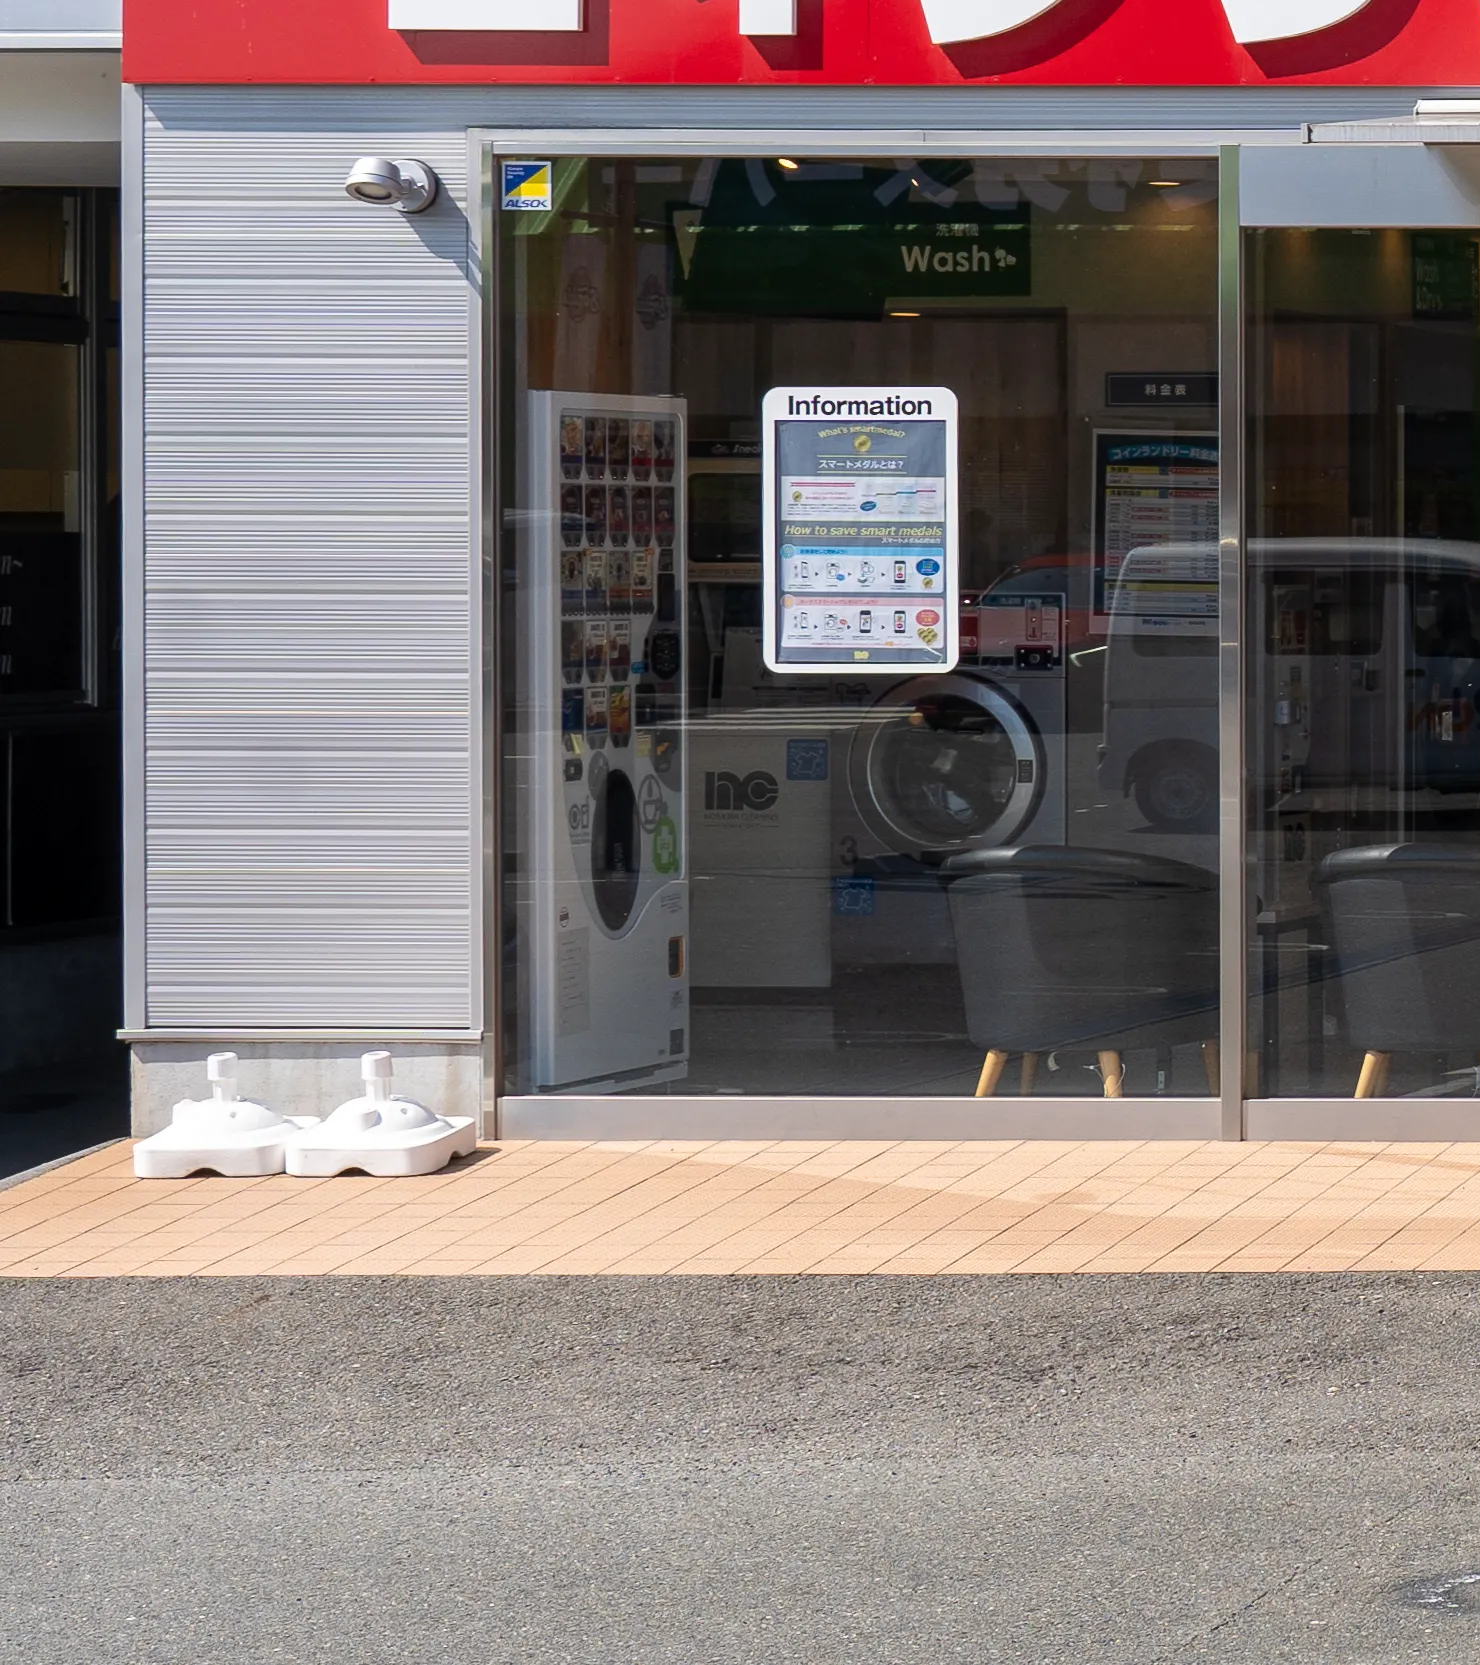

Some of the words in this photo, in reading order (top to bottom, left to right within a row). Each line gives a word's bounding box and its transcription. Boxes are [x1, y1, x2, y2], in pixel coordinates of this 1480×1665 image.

[504, 199, 548, 208] ALSOK
[900, 245, 991, 273] Wash
[1144, 384, 1187, 396] 料金表
[788, 394, 932, 416] Information
[784, 524, 812, 536] How
[814, 525, 827, 535] to
[830, 526, 857, 536] save
[860, 525, 896, 536] smart
[898, 525, 943, 536] medals
[704, 770, 779, 811] nc
